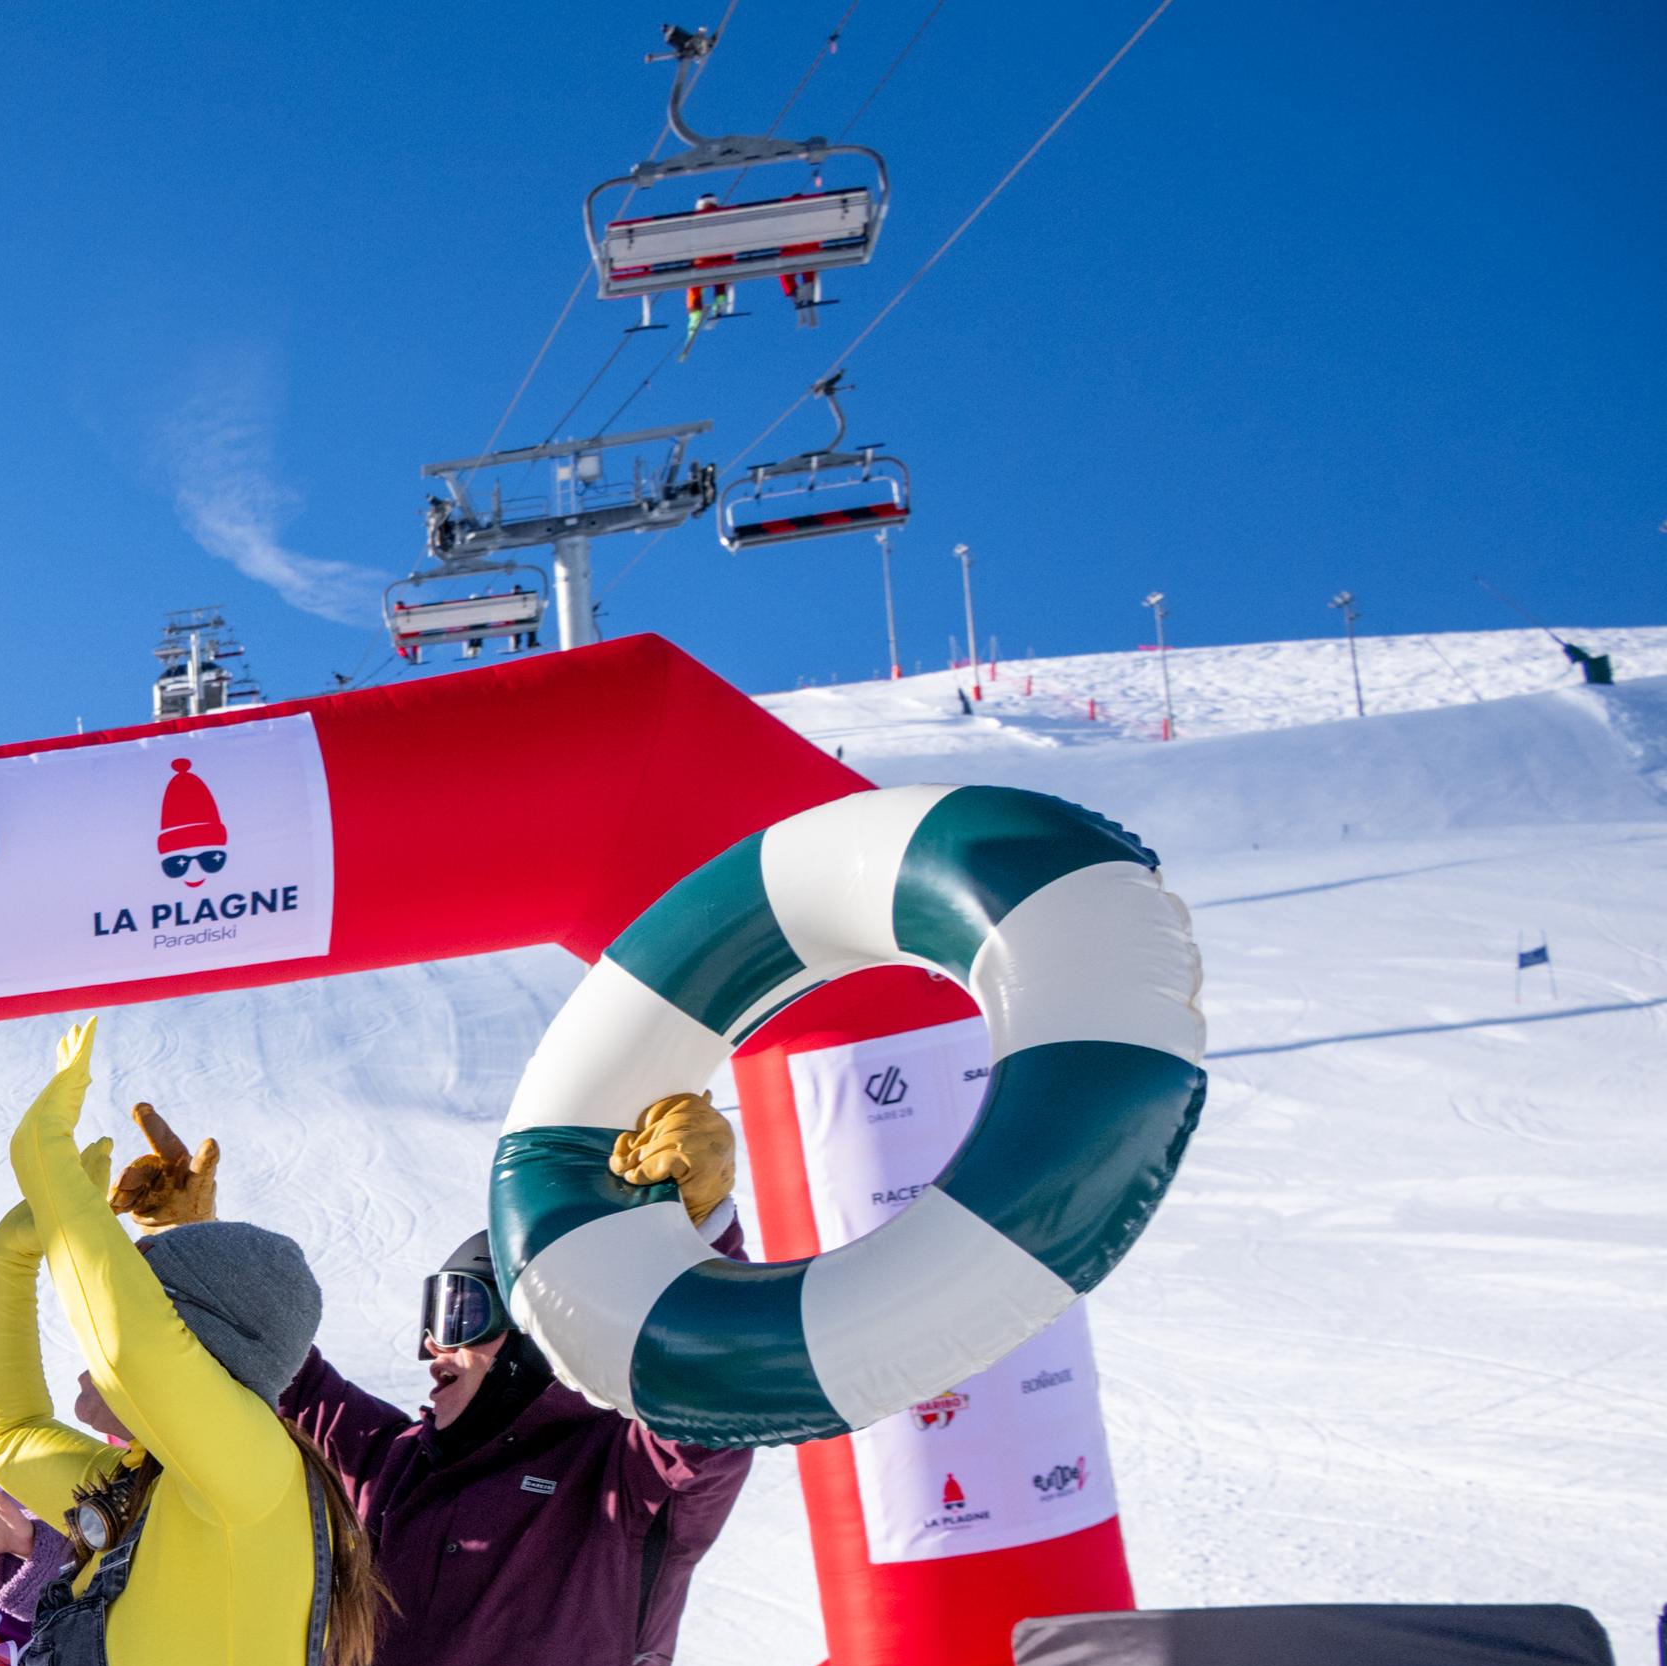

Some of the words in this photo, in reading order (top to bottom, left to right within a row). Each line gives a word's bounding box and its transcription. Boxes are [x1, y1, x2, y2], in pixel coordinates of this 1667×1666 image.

[93, 908, 138, 937] LA
[150, 885, 299, 930] PLAGNE
[152, 924, 238, 951] Paradiski
